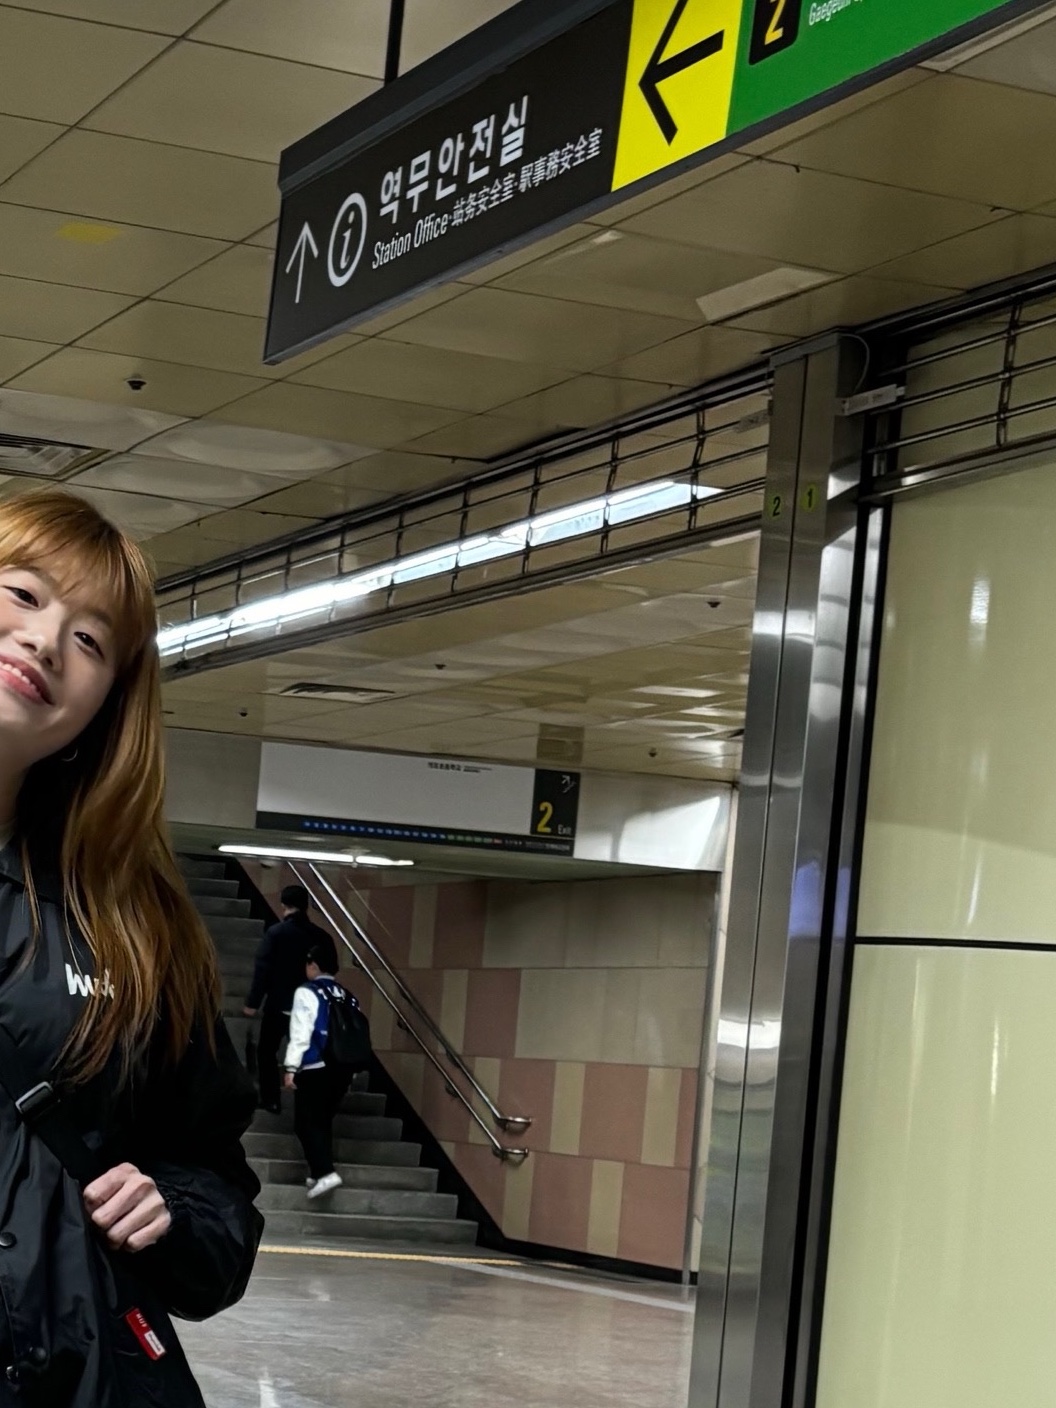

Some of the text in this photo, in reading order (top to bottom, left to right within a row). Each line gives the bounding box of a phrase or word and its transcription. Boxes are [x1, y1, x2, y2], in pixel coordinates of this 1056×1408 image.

[379, 95, 528, 224] 역무안전실
[372, 227, 411, 270] Station
[413, 212, 447, 248] Office
[772, 496, 781, 517] 2
[537, 801, 553, 833] 2
